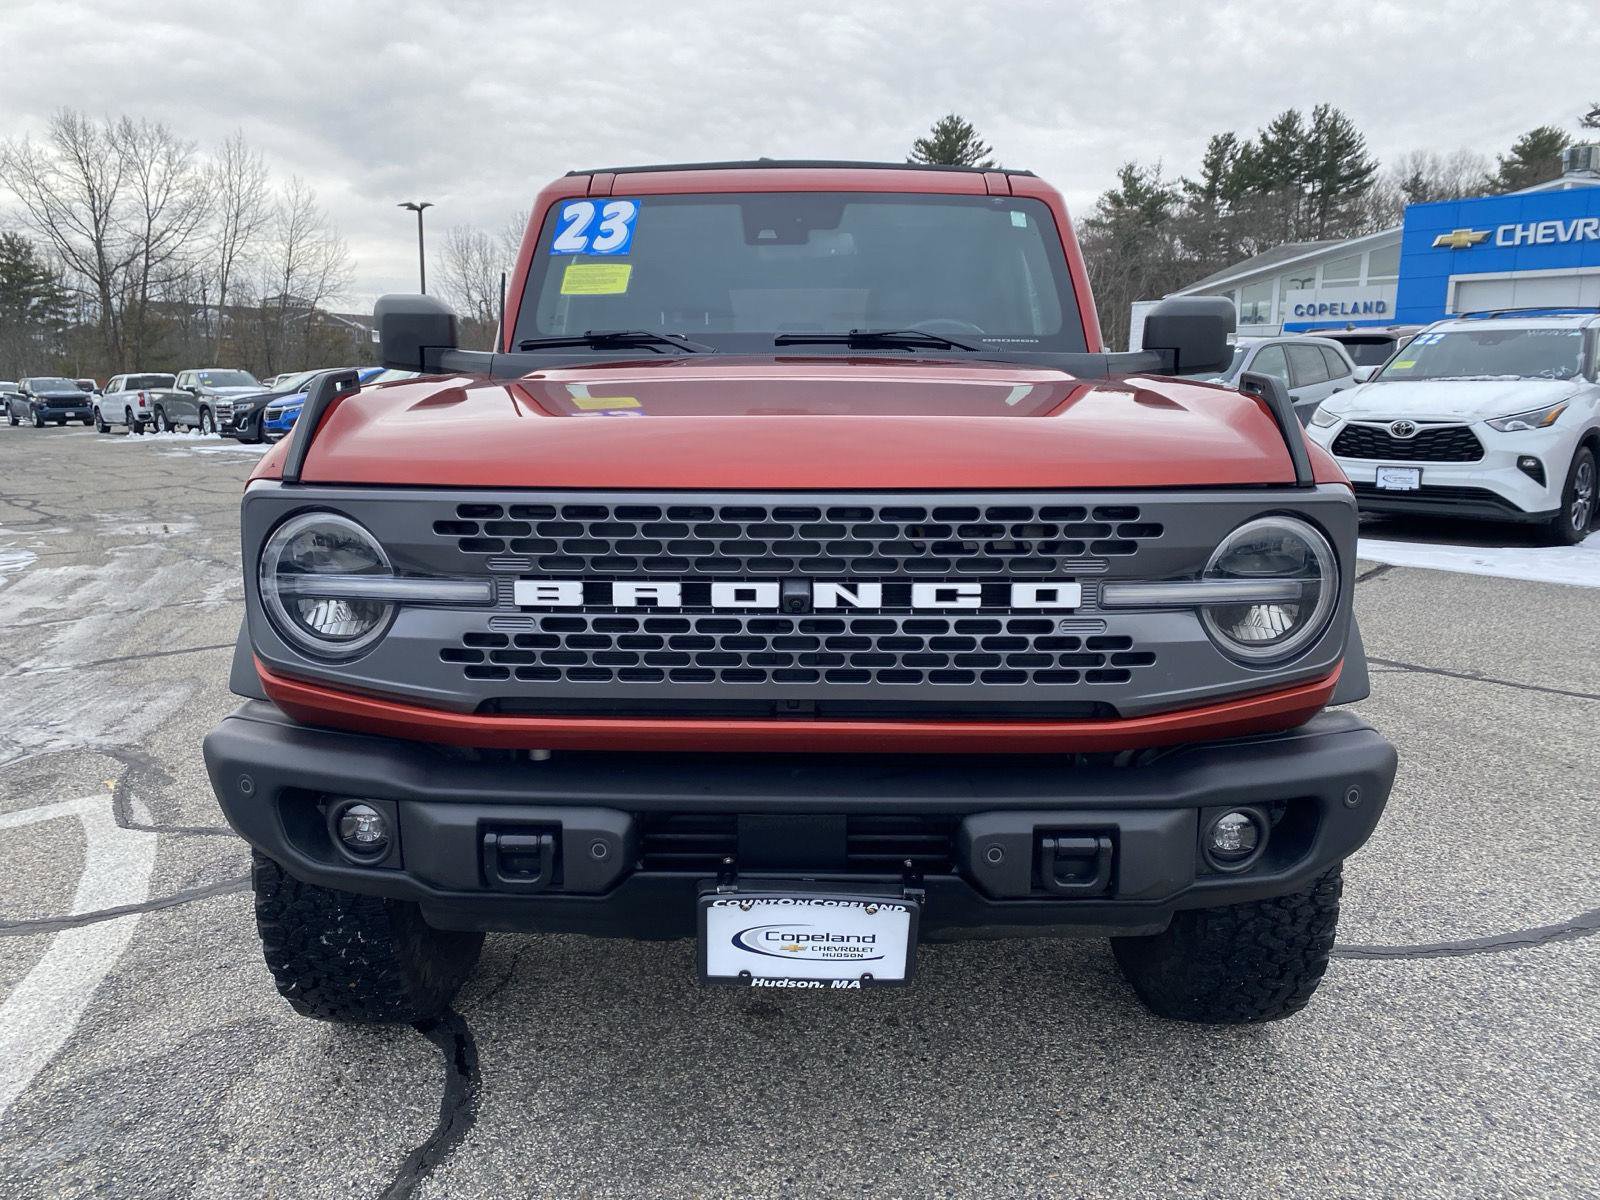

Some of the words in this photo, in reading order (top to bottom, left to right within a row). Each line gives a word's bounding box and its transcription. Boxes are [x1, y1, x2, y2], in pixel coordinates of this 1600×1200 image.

[553, 201, 636, 253] 23
[1496, 218, 1600, 247] CHEVR
[1294, 301, 1386, 317] COPELAND
[1413, 333, 1446, 345] 22
[513, 580, 1083, 609] BRONCO
[765, 931, 876, 944] Copeland
[811, 945, 875, 953] CHEVROLET
[750, 978, 825, 989] Hudson,
[830, 980, 861, 989] MA
